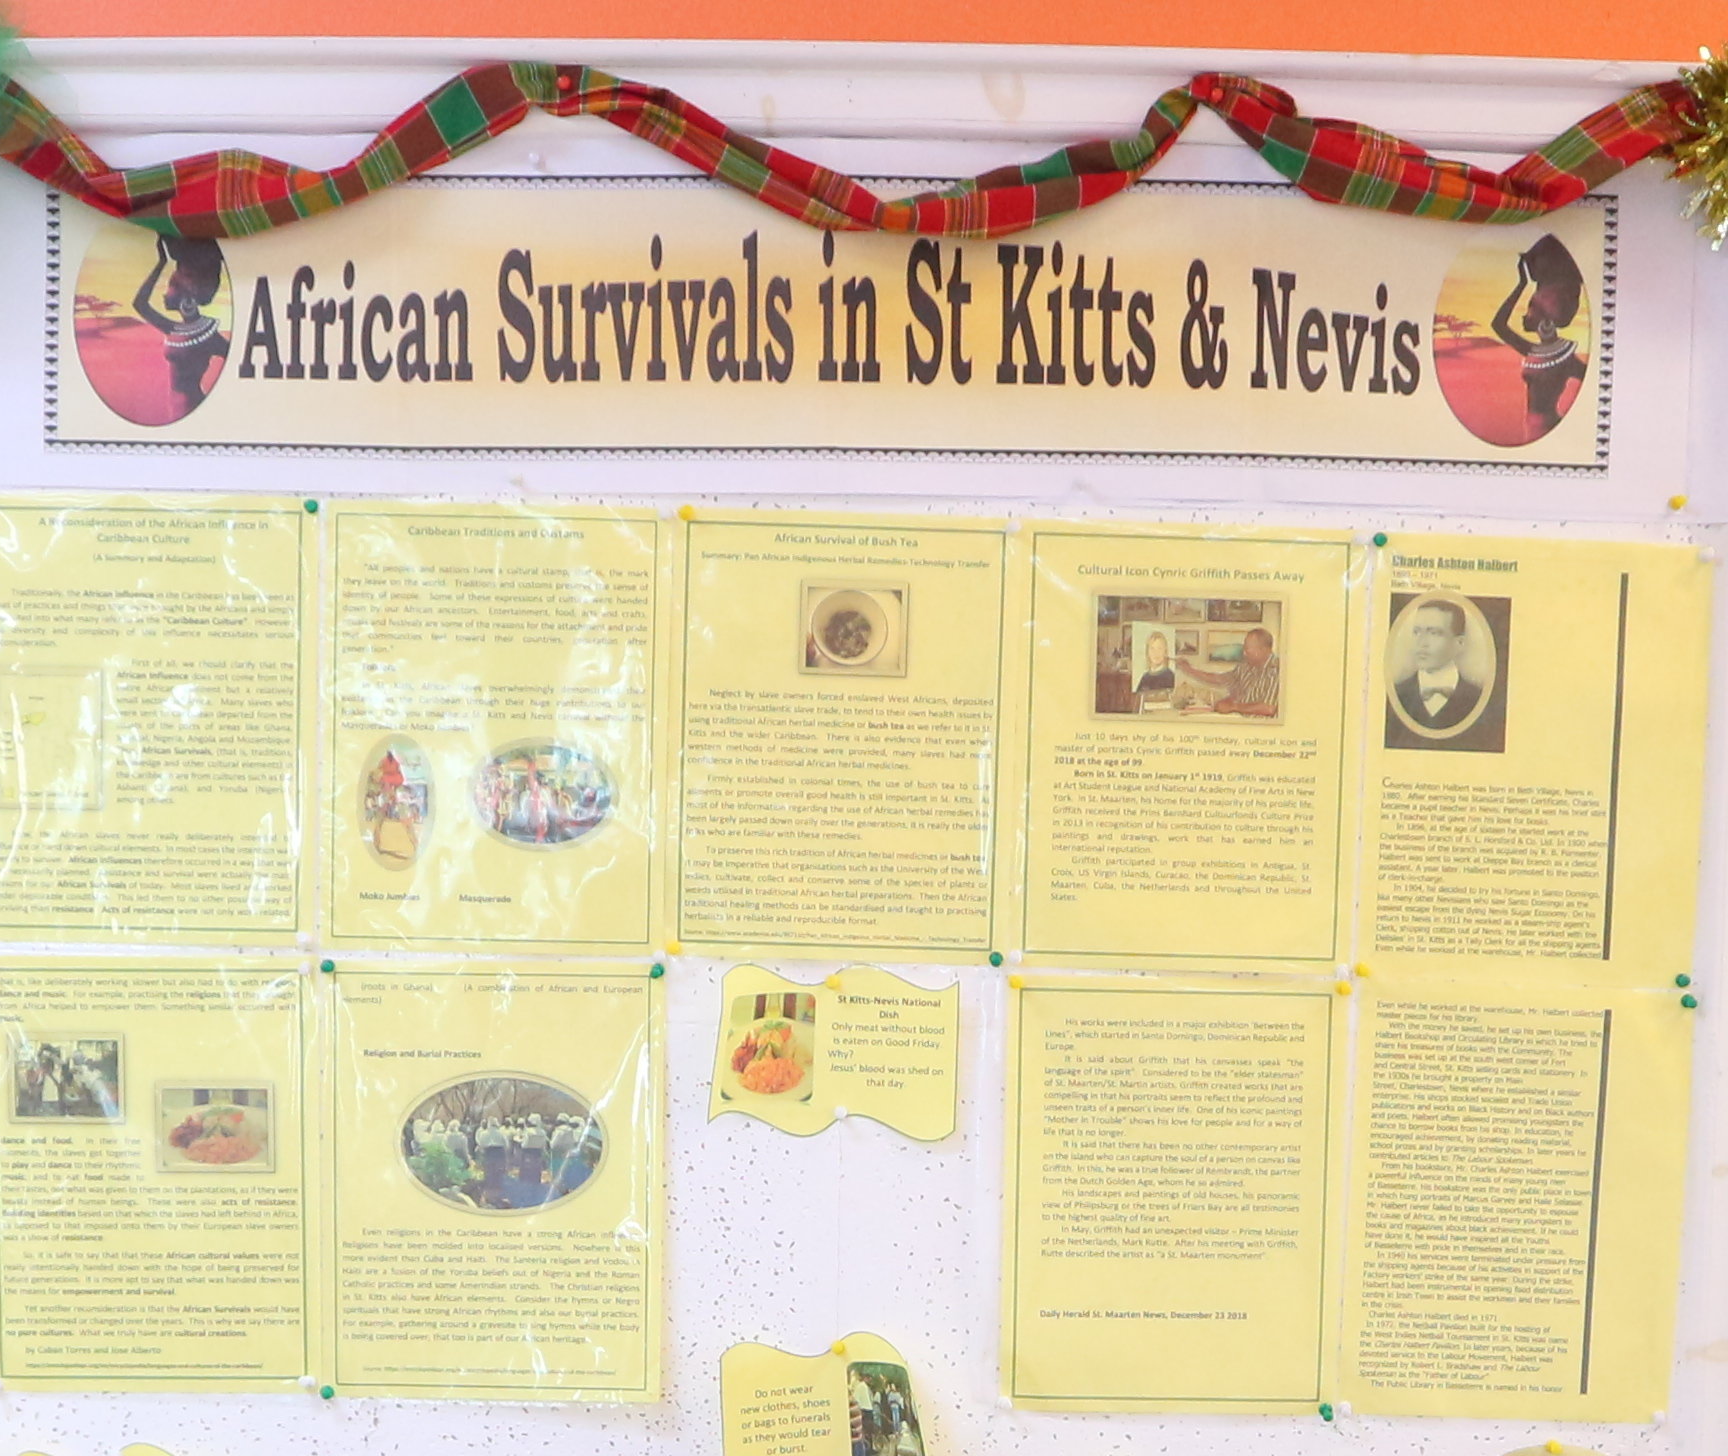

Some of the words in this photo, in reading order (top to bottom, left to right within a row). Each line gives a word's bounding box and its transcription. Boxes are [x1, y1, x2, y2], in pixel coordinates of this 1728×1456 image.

[238, 260, 473, 383] African
[497, 229, 795, 384] Survivals
[818, 230, 881, 383] in
[906, 238, 972, 385] St
[996, 241, 1155, 388] Kitts
[1180, 259, 1227, 390] &
[1251, 268, 1422, 395] Nevis
[775, 533, 811, 543] African
[815, 535, 856, 544] Survival
[859, 536, 869, 545] of
[872, 537, 897, 546] Bush
[900, 538, 918, 547] Tea
[1393, 556, 1434, 568] Charles
[1438, 557, 1474, 570] Ashton
[1478, 560, 1517, 572] Halbert
[1078, 564, 1122, 575] Cultural
[1126, 566, 1149, 576] Icon
[1153, 567, 1185, 579] Cynric
[1190, 568, 1230, 579] Griffith
[1234, 570, 1270, 580] Passes
[1274, 571, 1304, 583] Away
[838, 995, 846, 1003] St
[850, 996, 899, 1005] Kitts-Nevis
[902, 998, 941, 1007] National
[832, 1022, 853, 1032] Only
[881, 1024, 916, 1033] without
[919, 1025, 945, 1034] blood
[364, 1049, 397, 1058] Religion
[444, 1050, 481, 1058] Practices
[755, 1390, 768, 1398] Do
[771, 1388, 786, 1396] not
[790, 1386, 813, 1394] wear
[763, 1402, 799, 1412] clothes,
[803, 1400, 830, 1408] shoes
